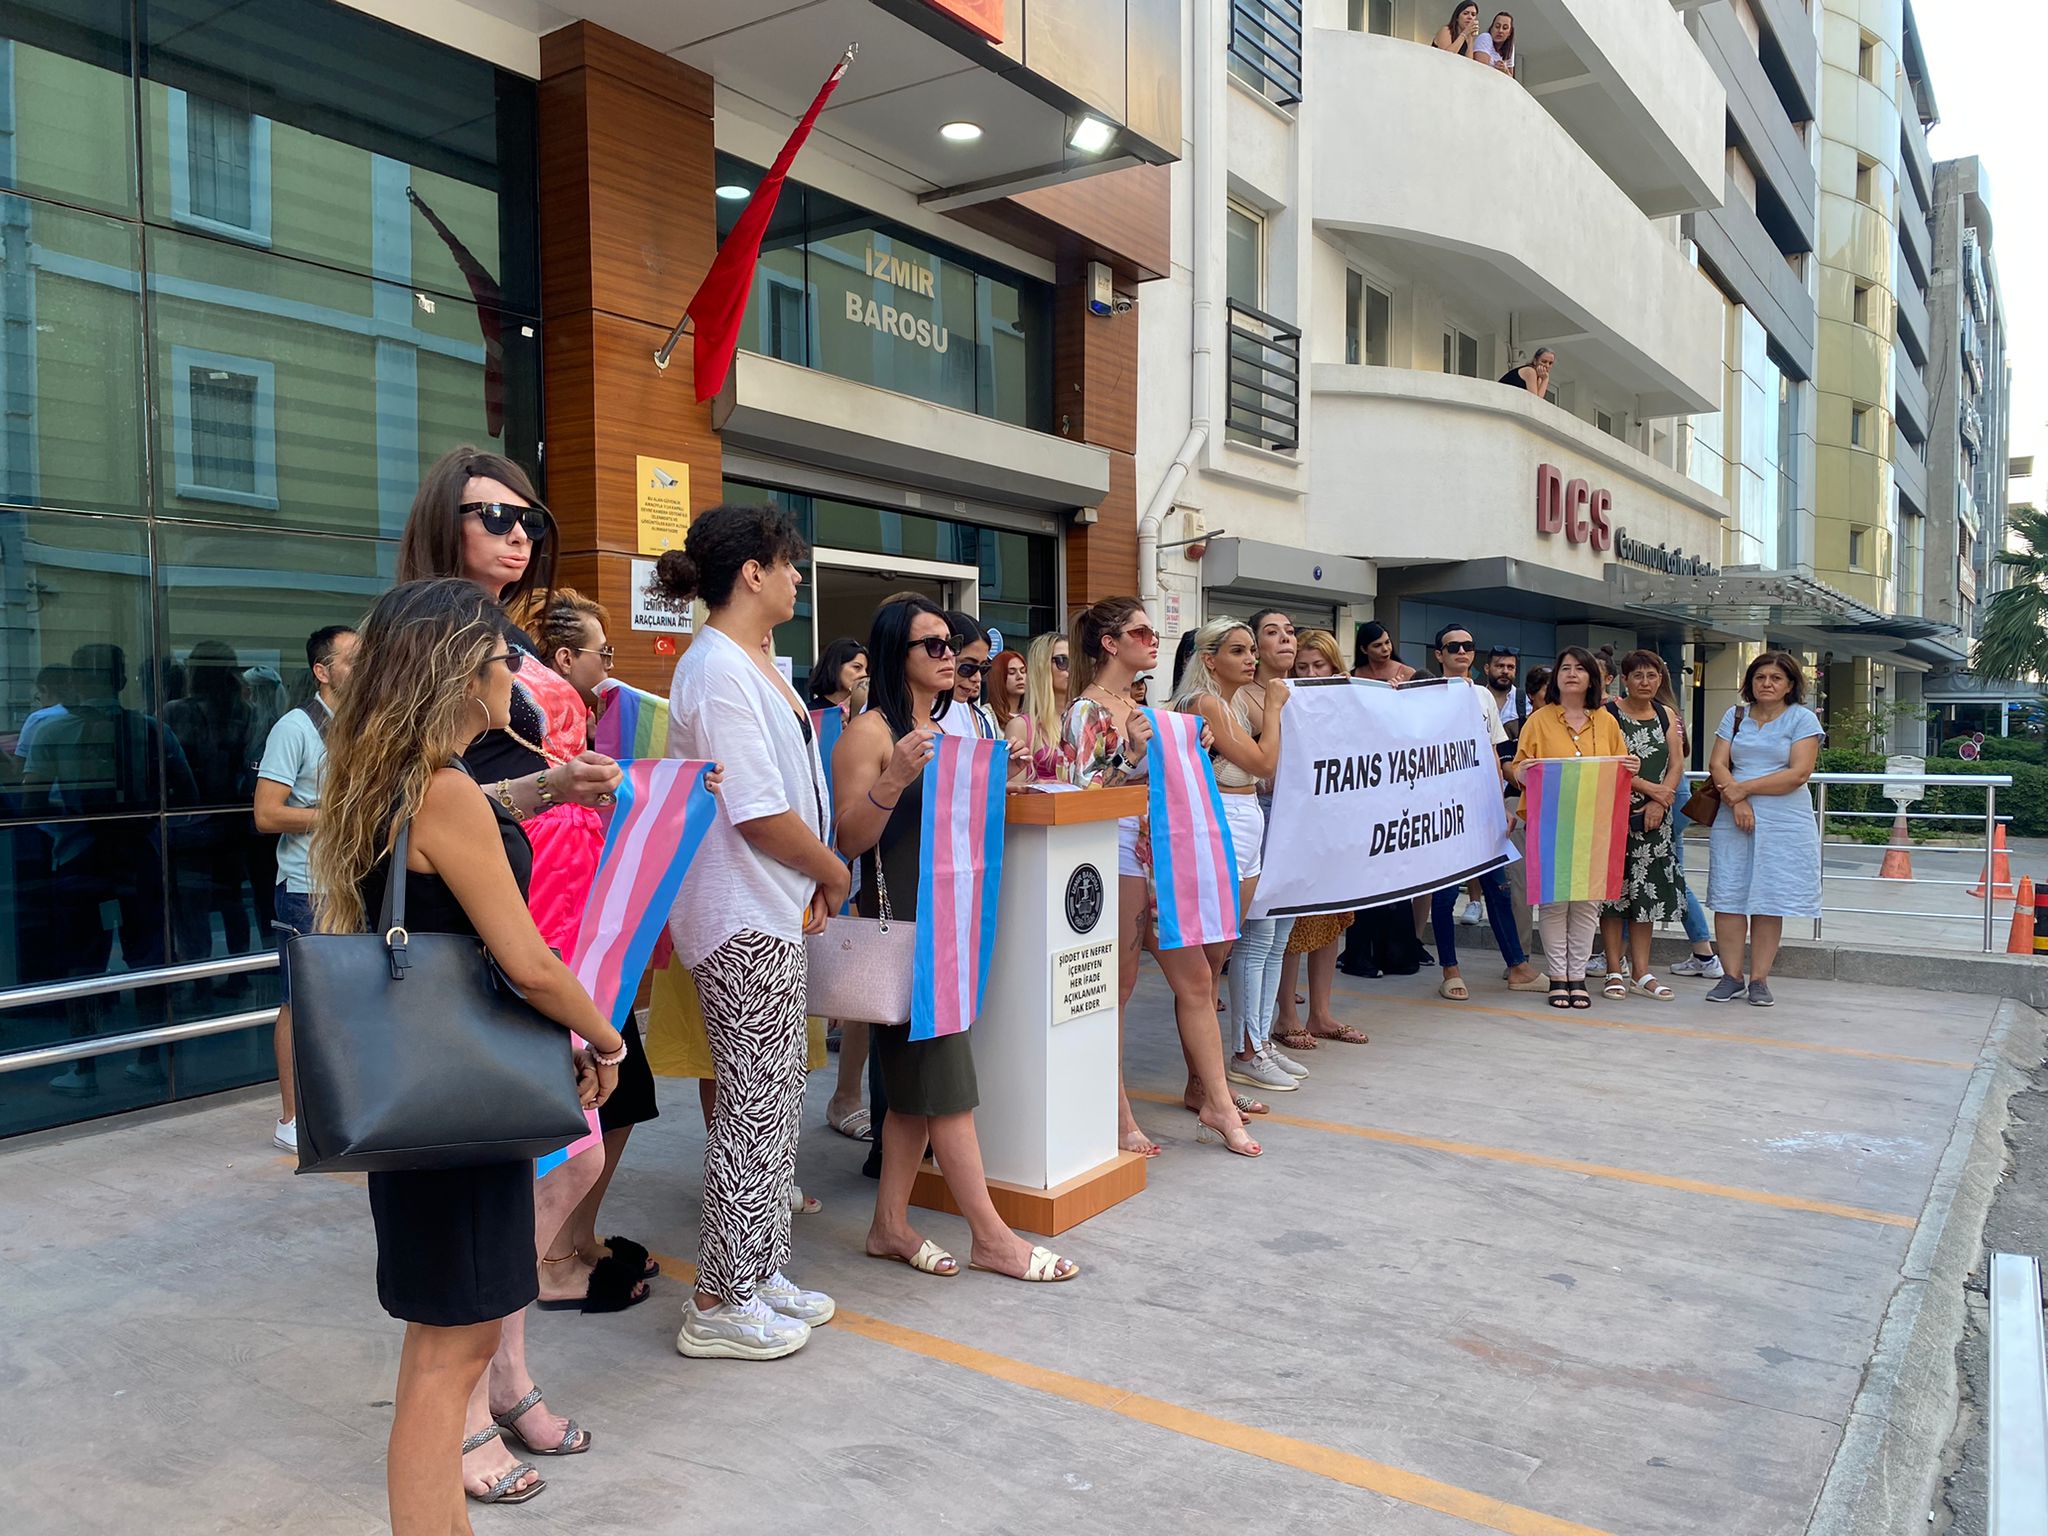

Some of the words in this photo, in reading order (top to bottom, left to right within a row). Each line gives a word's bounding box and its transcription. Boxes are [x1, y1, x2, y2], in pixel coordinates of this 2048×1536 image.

[865, 242, 935, 299] İZMİR
[846, 291, 948, 354] BAROSU
[1536, 463, 1612, 552] DCS
[1614, 526, 1692, 576] Communication
[634, 614, 677, 627] ARAÇLARINA
[1313, 752, 1382, 796] TRANS
[1387, 738, 1480, 791] YAŞAMLARIMIZ
[1369, 798, 1465, 857] DEĞERLİDİR
[1059, 951, 1080, 967] ŞİDDET
[1081, 949, 1089, 959] VE
[1090, 944, 1112, 956] NEFRET
[1068, 959, 1102, 977] İÇERMEYEN
[1063, 984, 1106, 1004] AÇIKLANMAYI
[1070, 978, 1082, 988] HER
[1083, 972, 1100, 985] İFADE
[1071, 1002, 1084, 1014] HAK
[1085, 998, 1100, 1011] EDER
